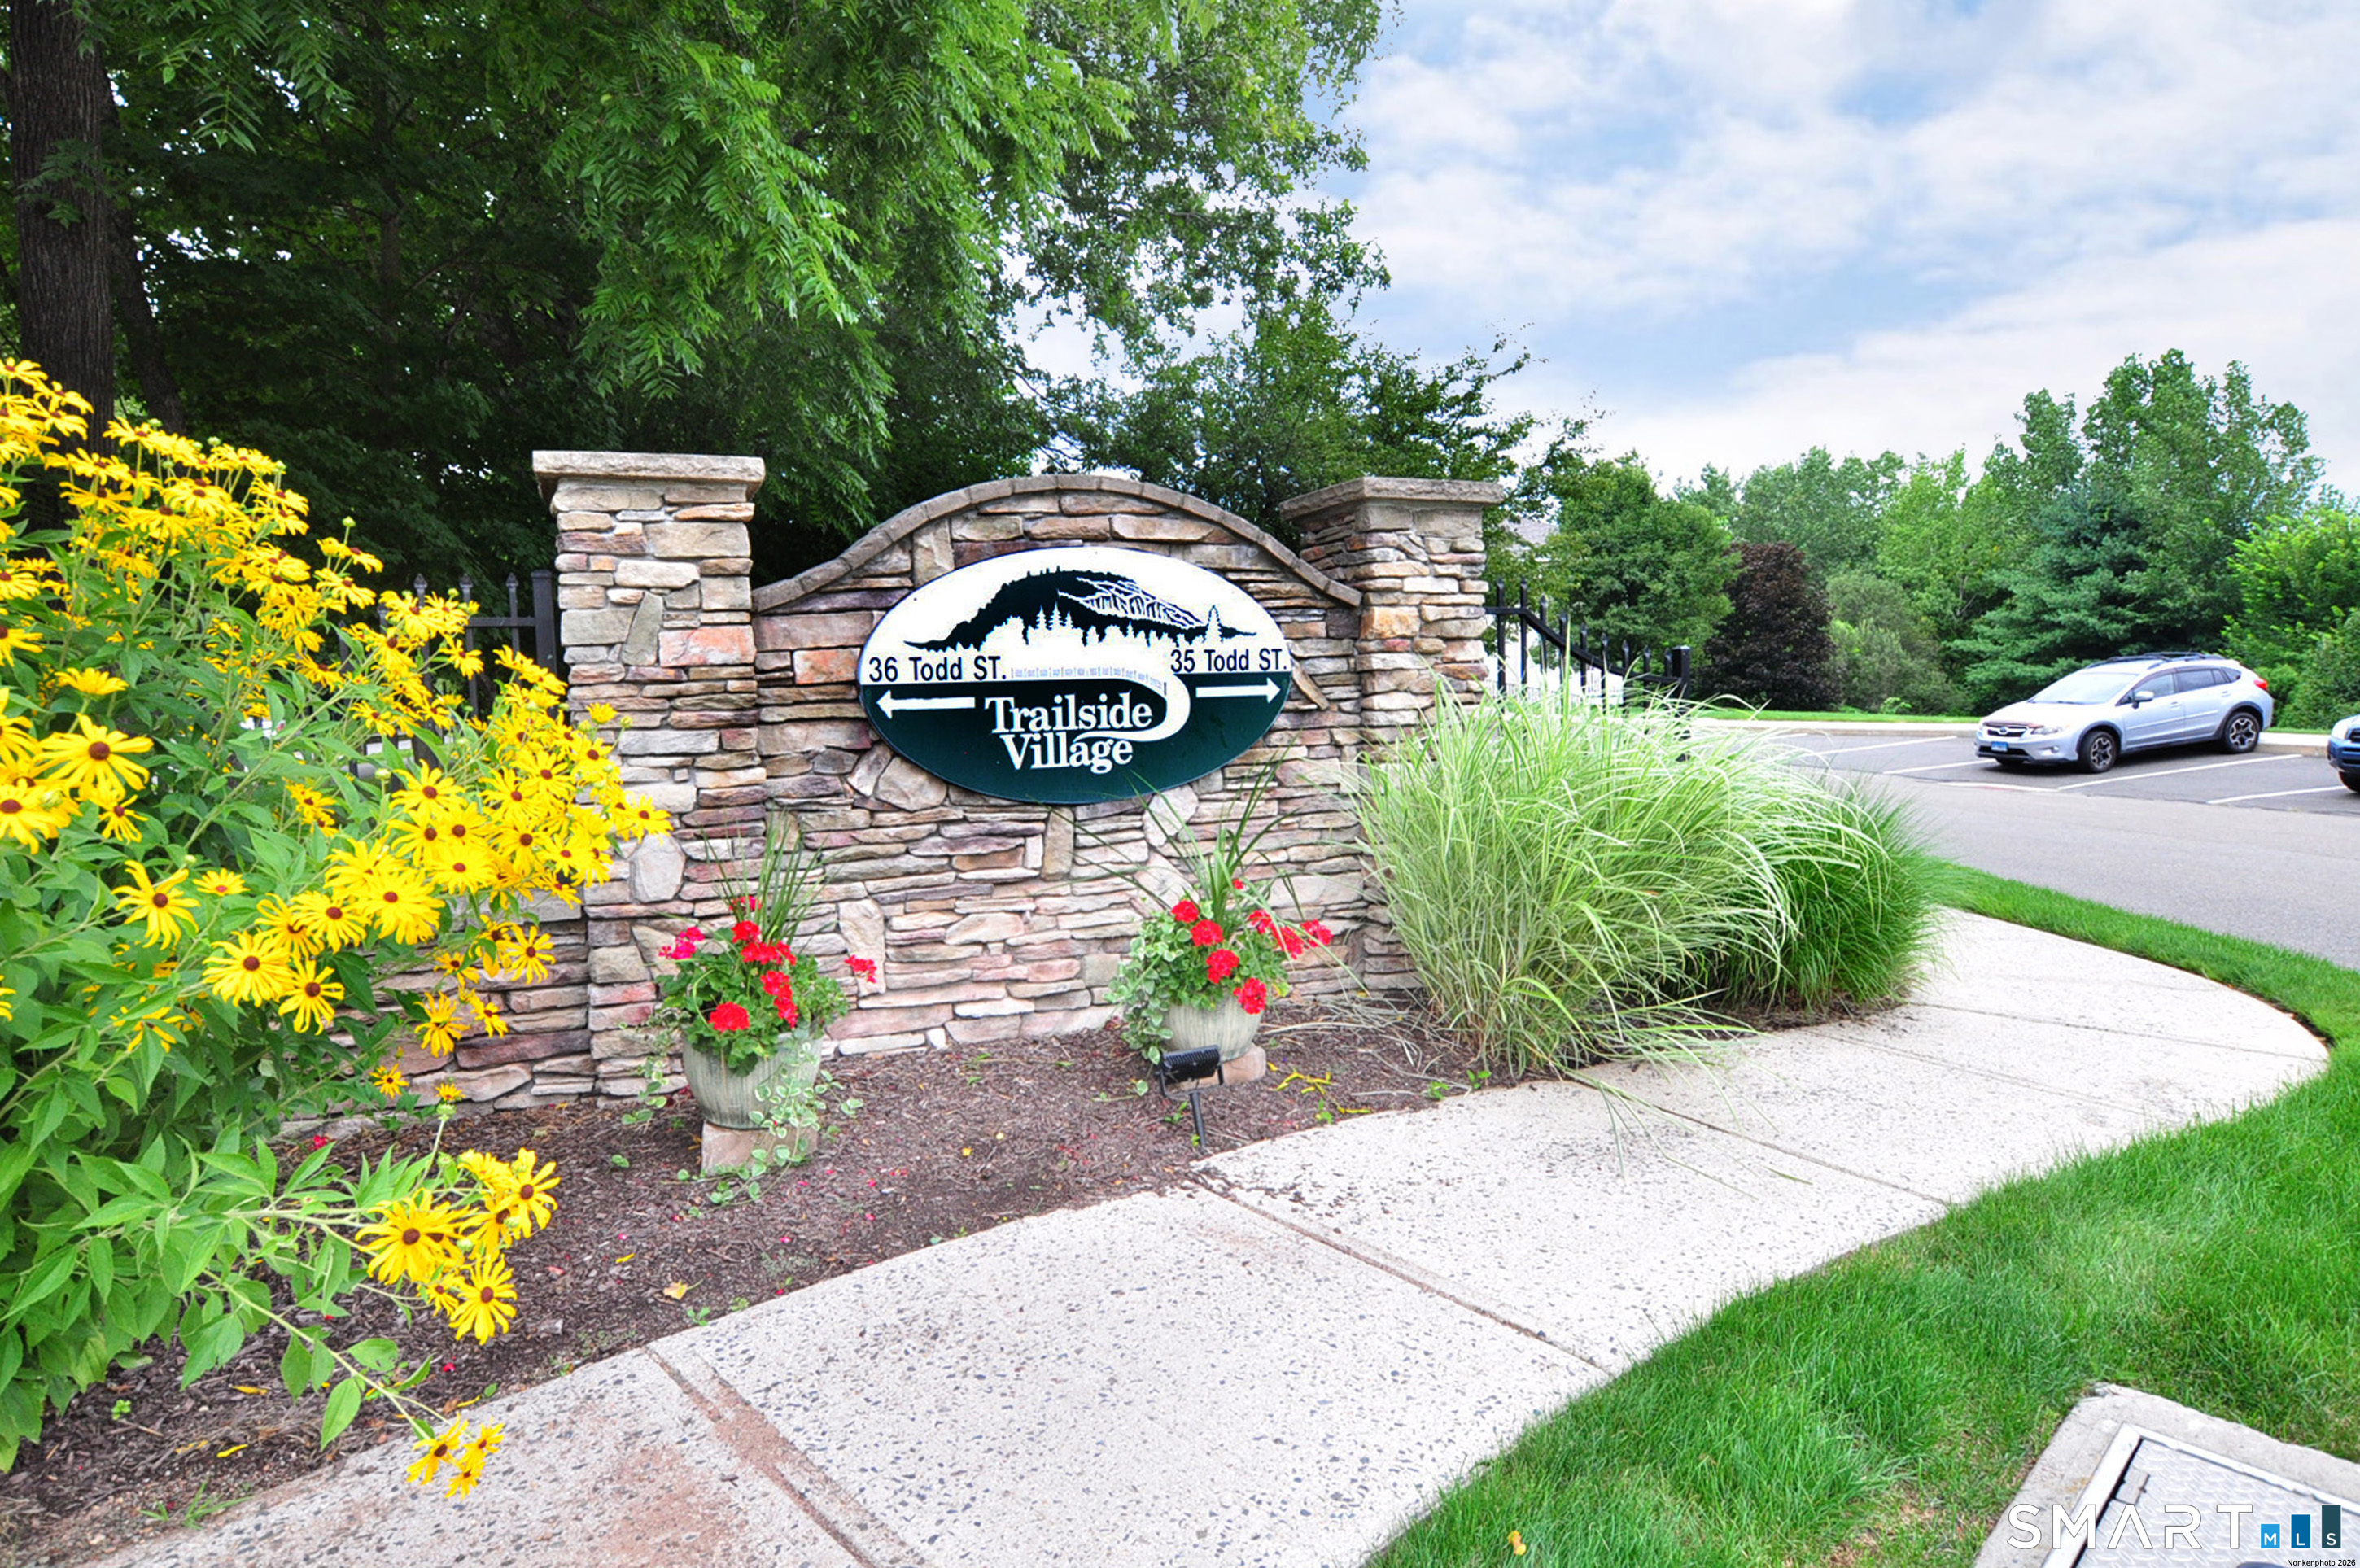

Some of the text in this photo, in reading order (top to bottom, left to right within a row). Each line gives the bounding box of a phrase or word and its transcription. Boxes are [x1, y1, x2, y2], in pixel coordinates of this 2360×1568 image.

[868, 655, 1007, 682] 36 Todd ST.
[1170, 648, 1287, 673] 35 Todd ST.
[984, 692, 1153, 735] Trailside
[999, 732, 1134, 775] Village
